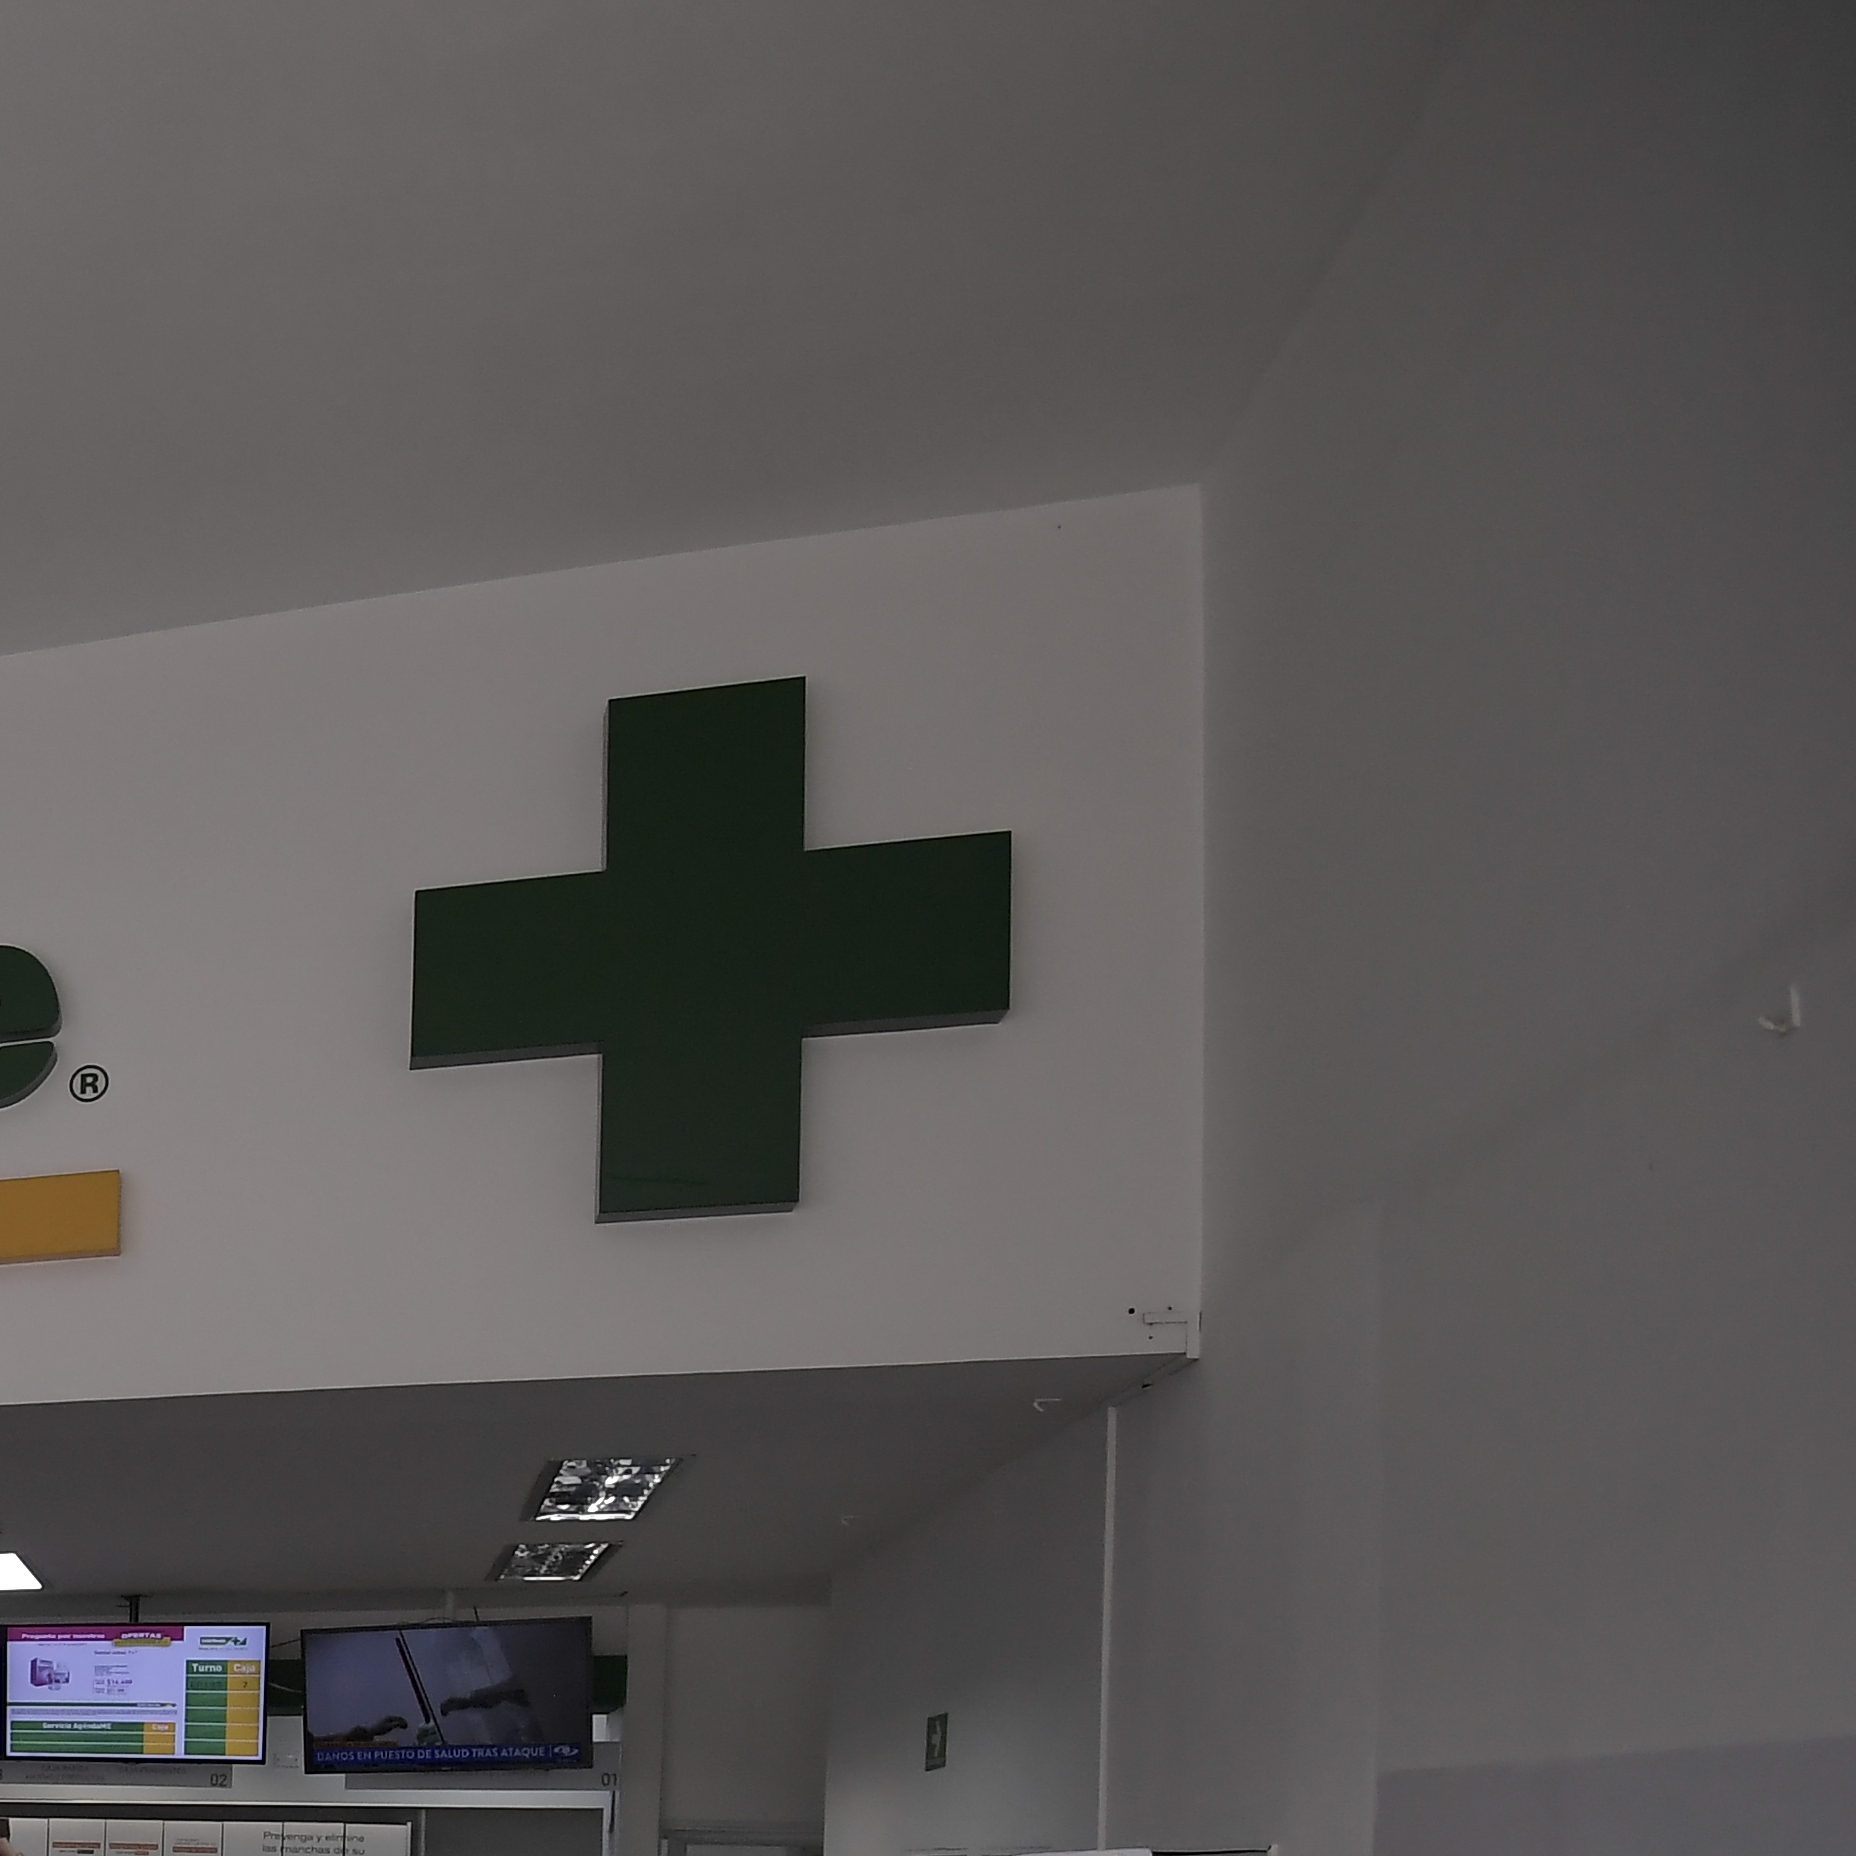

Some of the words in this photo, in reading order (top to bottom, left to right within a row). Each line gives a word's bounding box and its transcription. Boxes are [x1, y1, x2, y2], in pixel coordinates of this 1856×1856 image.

[192, 1663, 222, 1673] Turno
[233, 1663, 256, 1674] Caja
[357, 1751, 371, 1760] EN
[374, 1749, 414, 1760] PUESTO
[417, 1749, 432, 1759] DE
[435, 1748, 470, 1759] SALUD
[471, 1748, 497, 1758] TRAS
[500, 1747, 545, 1758] ATAQUE
[210, 1774, 227, 1787] 02
[601, 1773, 618, 1786] 01
[263, 1832, 313, 1843] Prevenga
[317, 1835, 322, 1844] y
[325, 1834, 364, 1842] elimine
[262, 1844, 277, 1853] las
[280, 1845, 330, 1855] manchas
[333, 1845, 348, 1854] de
[352, 1847, 365, 1855] su
